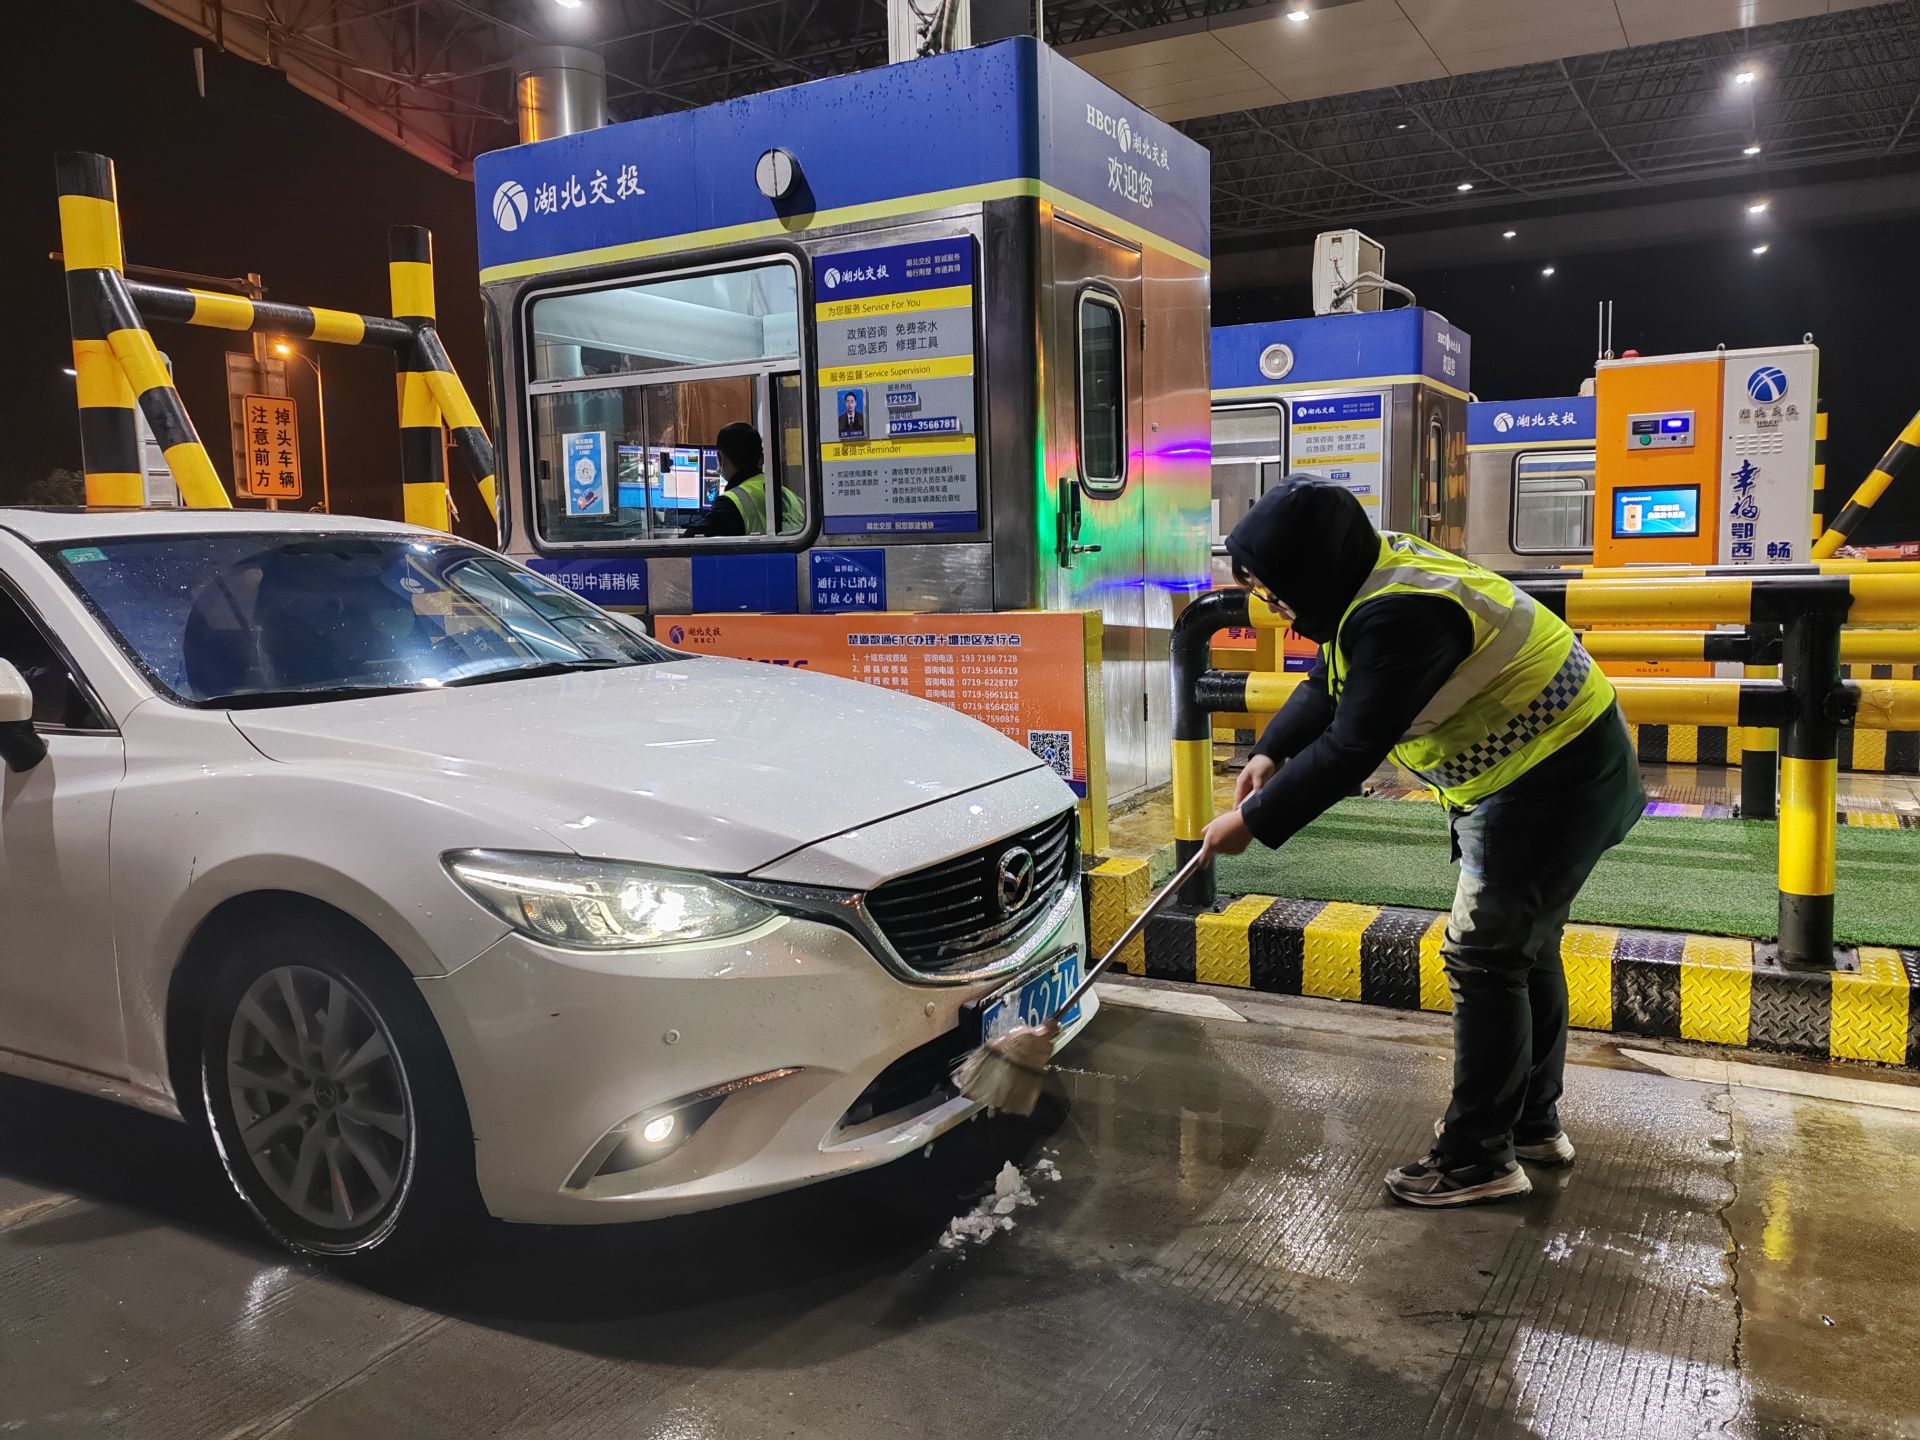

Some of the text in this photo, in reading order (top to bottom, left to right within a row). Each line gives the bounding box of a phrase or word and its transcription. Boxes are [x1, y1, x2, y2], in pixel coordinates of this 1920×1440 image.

[1086, 103, 1117, 140] HBCI
[1132, 131, 1170, 171] 湖北交投
[534, 164, 646, 216] 湖北交投
[1107, 156, 1154, 209] 欢迎您
[841, 264, 890, 284] 湖北交投
[828, 299, 921, 317] 为您服务 Service For You
[847, 320, 938, 340] 政策咨询 免费茶水
[847, 336, 938, 356] 应急医药 修理工具
[830, 366, 931, 382] 服务监督 Service Supervision
[888, 394, 913, 404] 12122
[891, 419, 956, 432] 0719-3566781
[1516, 411, 1577, 427] 湖北交投
[251, 406, 271, 487] 注意前方
[275, 407, 295, 489] 掉头车辆
[832, 446, 901, 457] 温馨提示 Reminder
[1731, 459, 1759, 564] 幸福鄂西
[1767, 541, 1791, 564] 畅
[817, 576, 878, 589] 通行卡已消毒
[818, 592, 878, 604] 请放心使用
[688, 626, 722, 637] 湖北交投
[977, 655, 997, 663] 7198
[998, 655, 1018, 663] 7128
